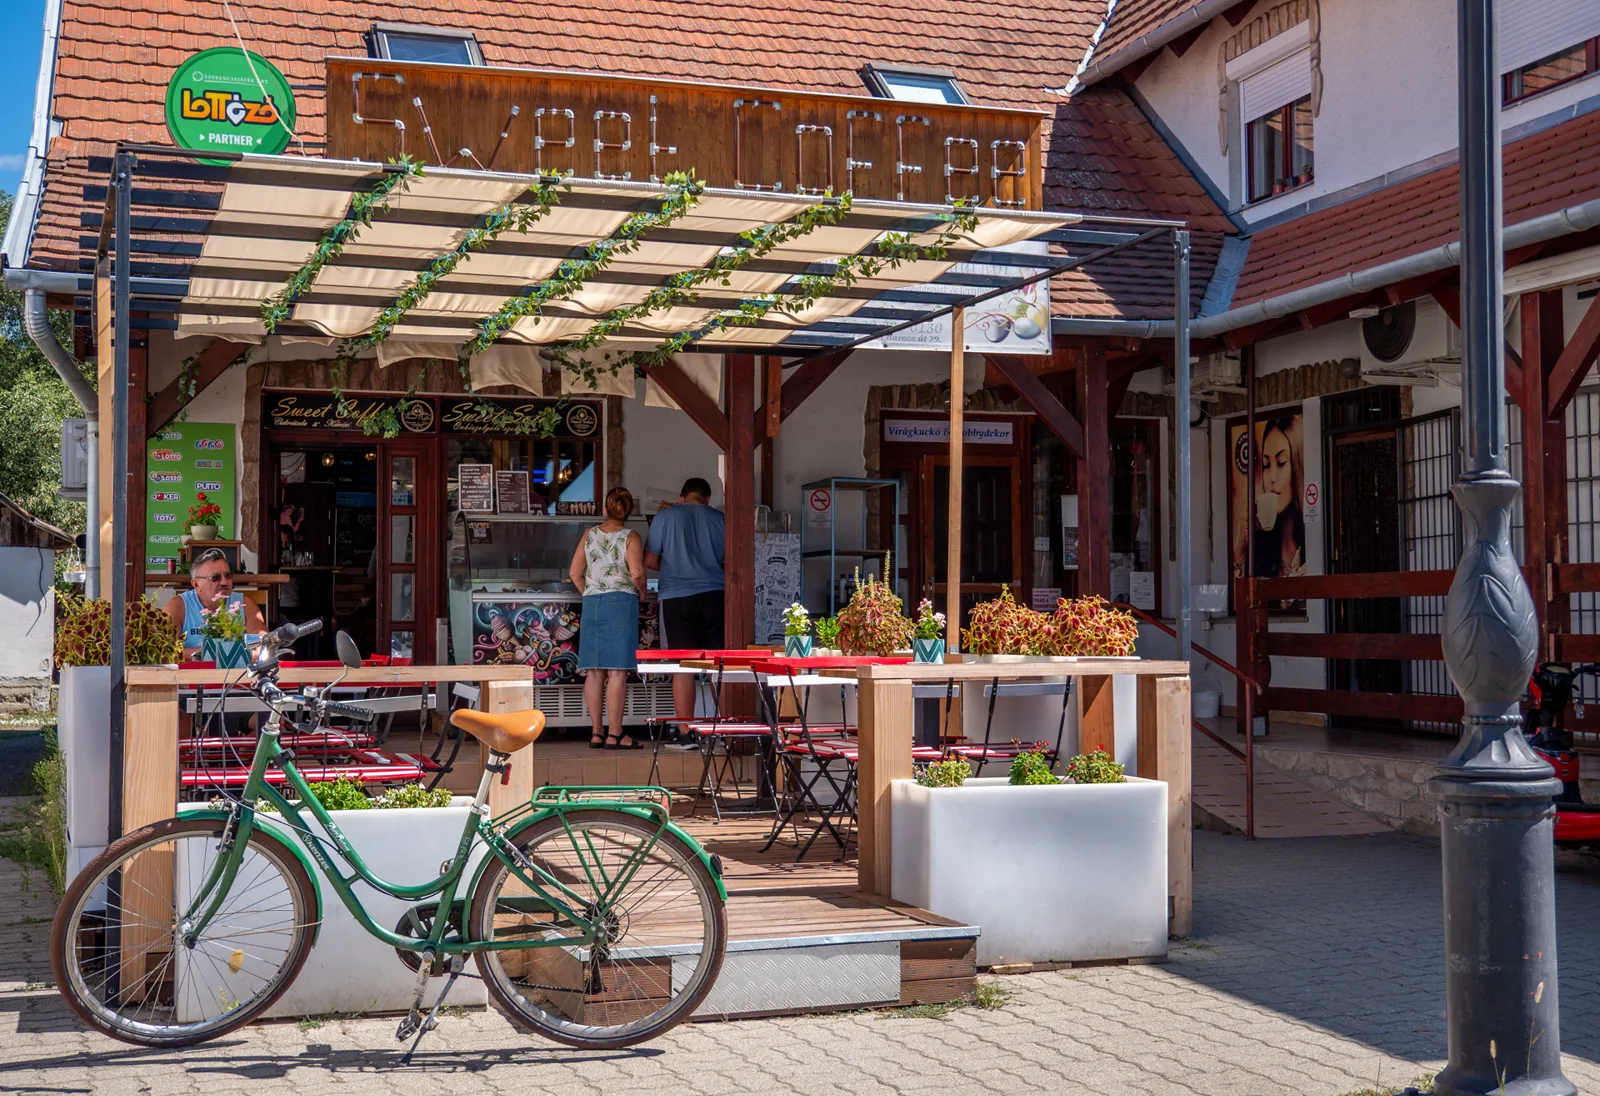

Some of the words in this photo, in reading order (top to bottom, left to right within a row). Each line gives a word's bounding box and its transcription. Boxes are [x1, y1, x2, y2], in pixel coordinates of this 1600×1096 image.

[208, 132, 253, 146] PARTNER
[271, 397, 333, 417] Sweet
[888, 426, 941, 438] Virágkuckó
[962, 428, 1010, 439] obbydekor
[152, 493, 179, 501] JOKER
